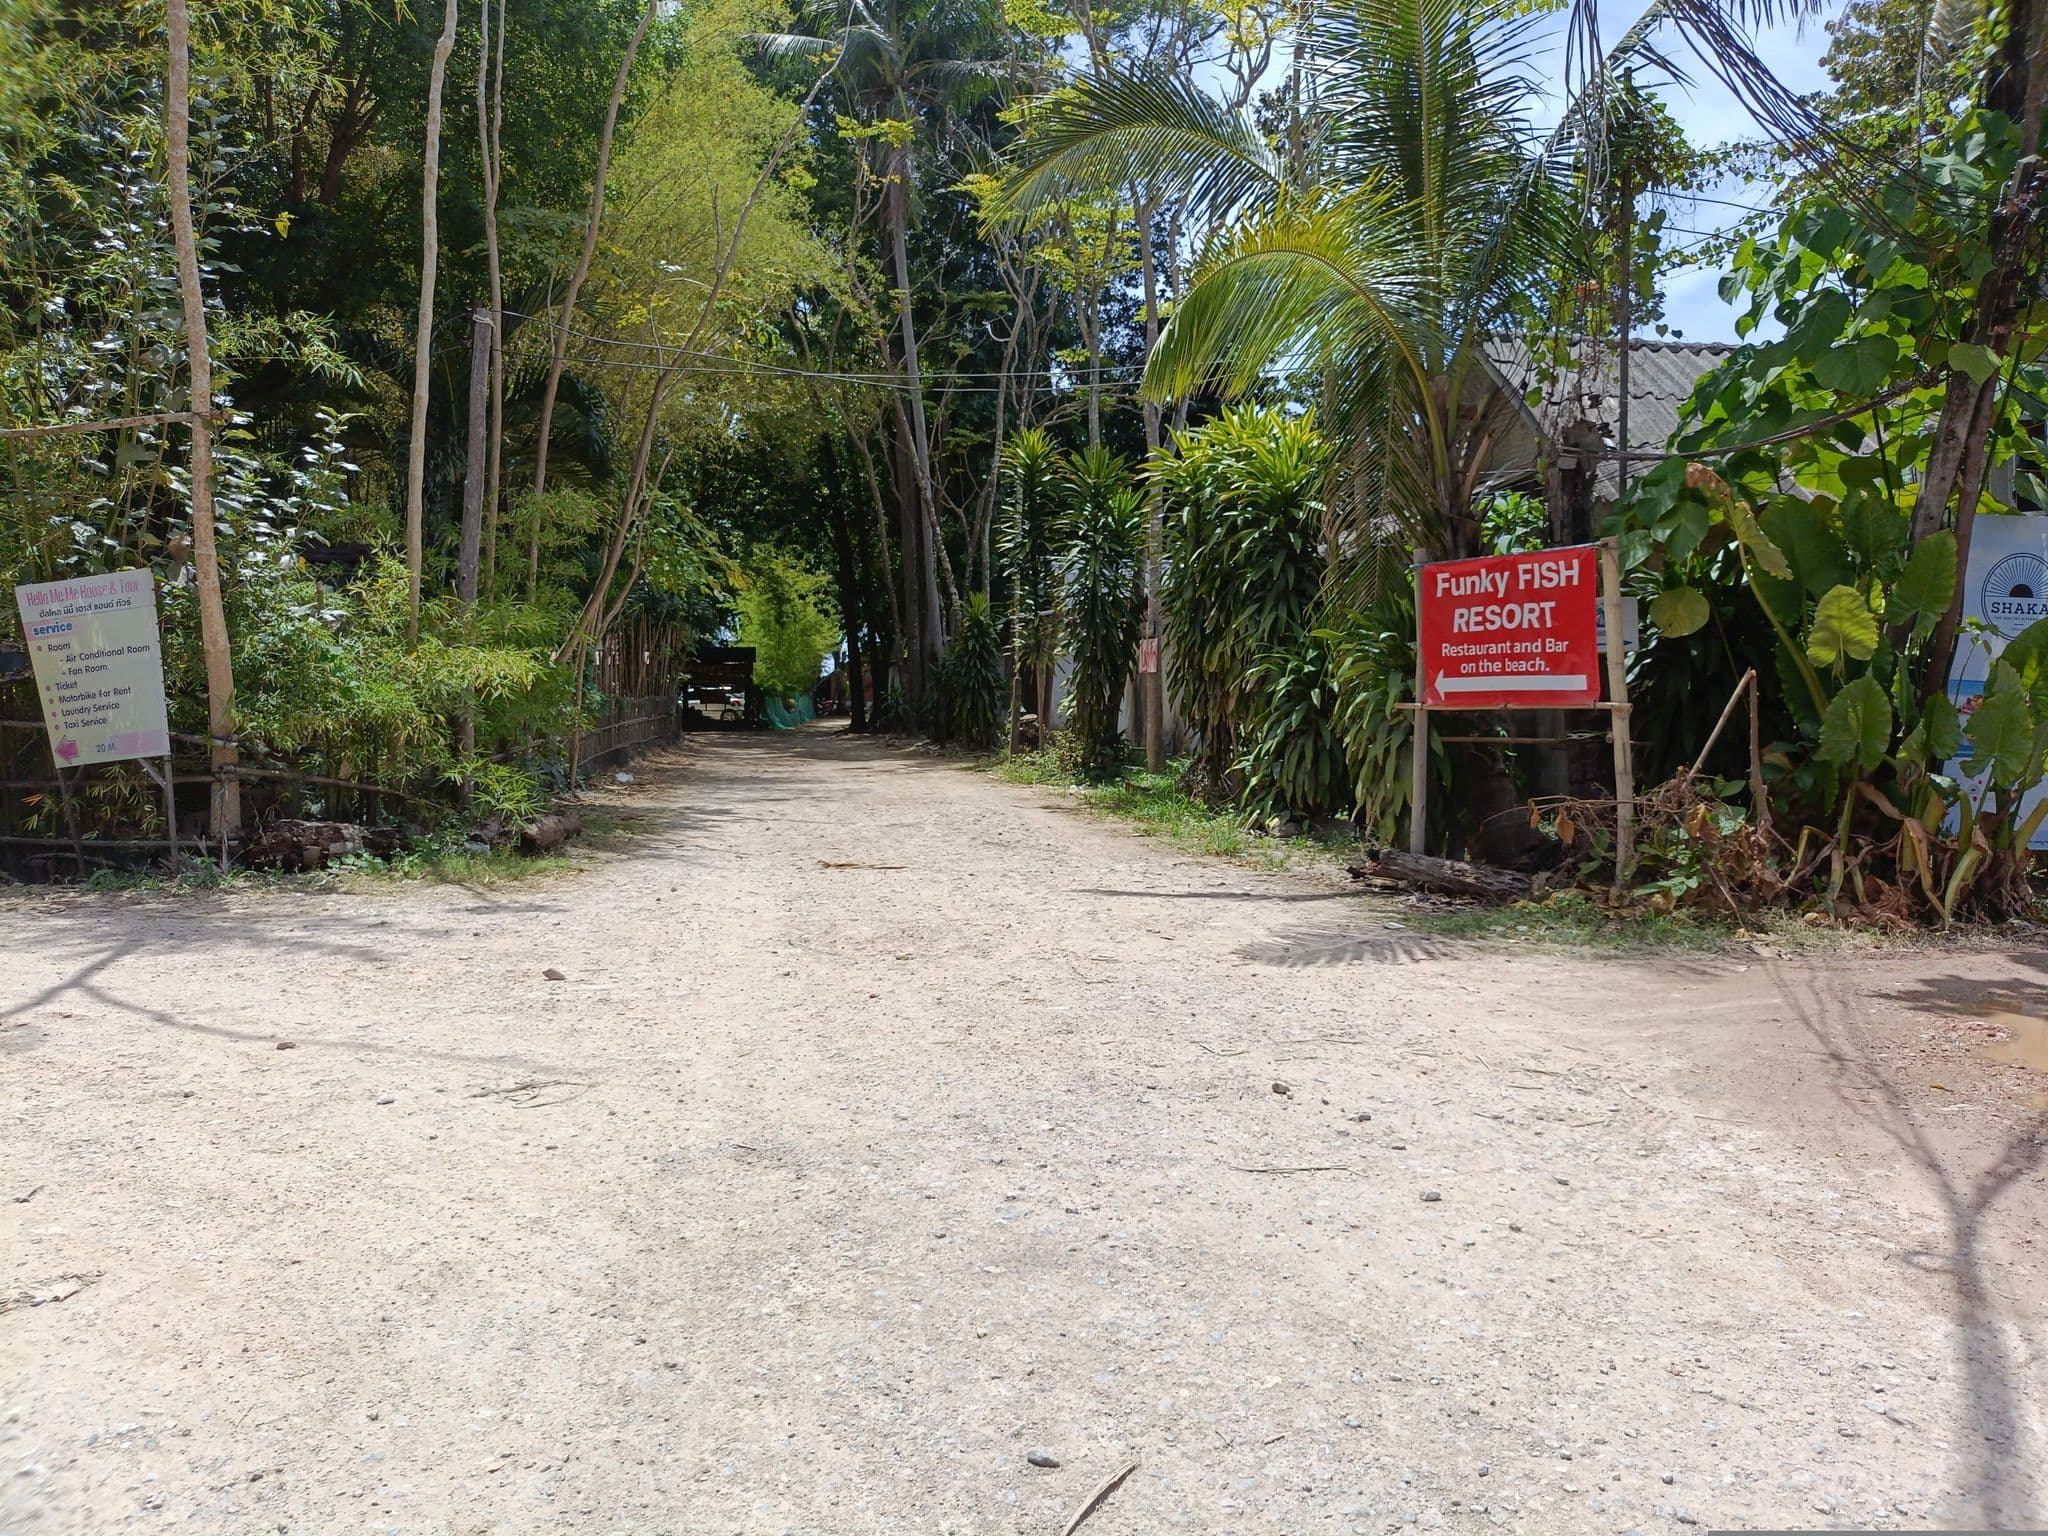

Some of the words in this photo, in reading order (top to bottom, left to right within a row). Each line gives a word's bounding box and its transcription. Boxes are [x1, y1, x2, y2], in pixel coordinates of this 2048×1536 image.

[1435, 568, 1510, 598] Funky
[1517, 559, 1581, 590] FISH
[26, 591, 49, 606] Hello
[65, 586, 79, 601] Me
[1991, 602, 2048, 615] SHAKA
[1453, 601, 1556, 634] RESORT
[33, 621, 73, 635] service
[48, 642, 70, 652] Room
[66, 654, 76, 663] Air
[79, 647, 125, 661] Conditional
[127, 644, 150, 654] Room
[1441, 641, 1512, 657] Restaurant
[1513, 638, 1542, 655] and
[1545, 638, 1569, 653] Bar
[68, 667, 83, 676] Fan
[85, 664, 108, 673] Room
[1460, 661, 1476, 674] on
[1479, 659, 1502, 673] the
[1504, 657, 1551, 673] beach.
[55, 680, 78, 691] Ticket
[59, 691, 97, 704] Motorbike
[99, 688, 111, 697] For
[113, 686, 131, 696] Rent
[61, 704, 91, 717] Laundry
[93, 702, 120, 712] Service
[64, 720, 79, 730] Taxi
[81, 717, 108, 727] Service
[96, 743, 106, 753] 20
